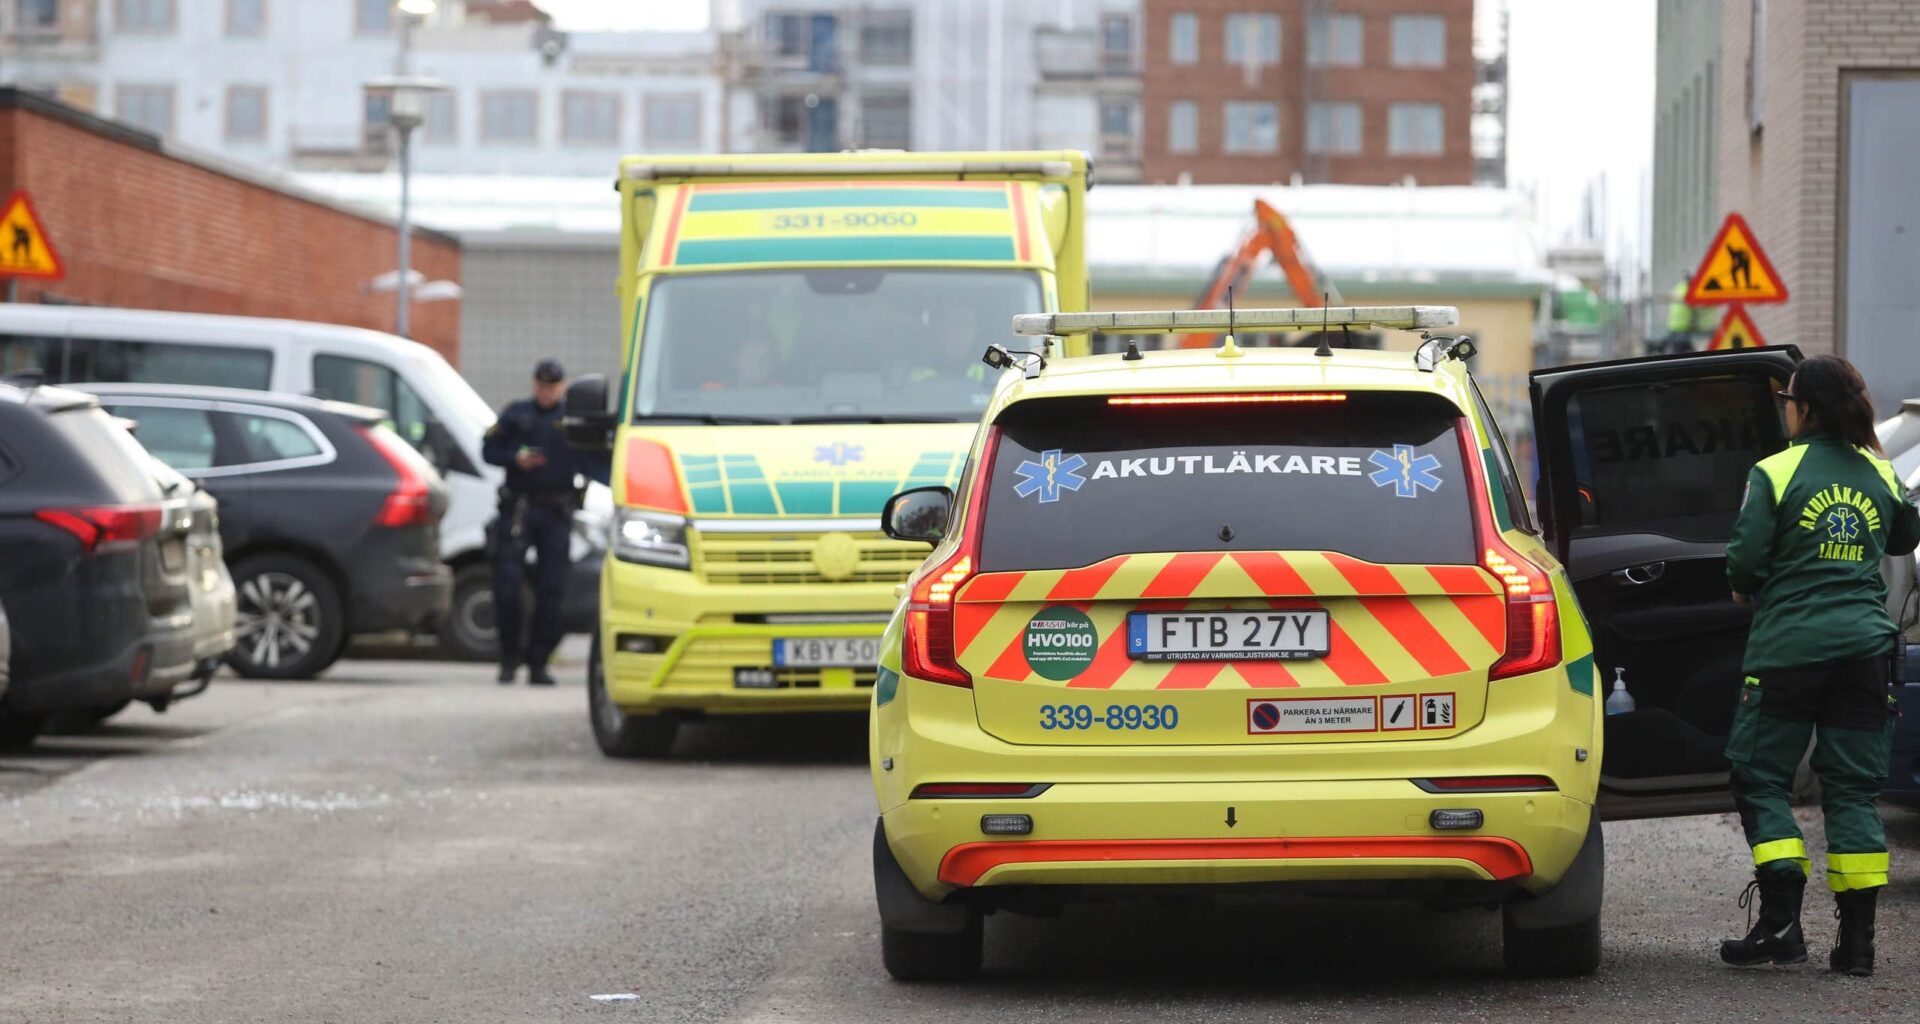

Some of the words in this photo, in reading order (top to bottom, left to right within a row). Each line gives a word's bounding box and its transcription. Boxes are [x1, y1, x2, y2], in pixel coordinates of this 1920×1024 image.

[774, 212, 917, 229] 331-9060
[1091, 451, 1362, 480] AKUTLÄKARE
[1799, 483, 1880, 532] AKUTLÄKARBIL
[1818, 540, 1864, 561] LÄKARE
[1028, 633, 1092, 647] HVO100
[1161, 616, 1228, 648] FTB
[1242, 615, 1312, 647] 27Y
[793, 639, 836, 660] KBY
[1135, 638, 1142, 647] S
[1167, 652, 1199, 660] UTRUSTAD
[1211, 651, 1289, 659] VARNINGSLJUSTEKNIK.SE
[1039, 704, 1179, 730] 339-8930
[1283, 708, 1321, 716] PARKERA
[1333, 706, 1373, 715] NÄRMARE
[1305, 716, 1317, 725] ÄN
[1324, 716, 1352, 724] METER
